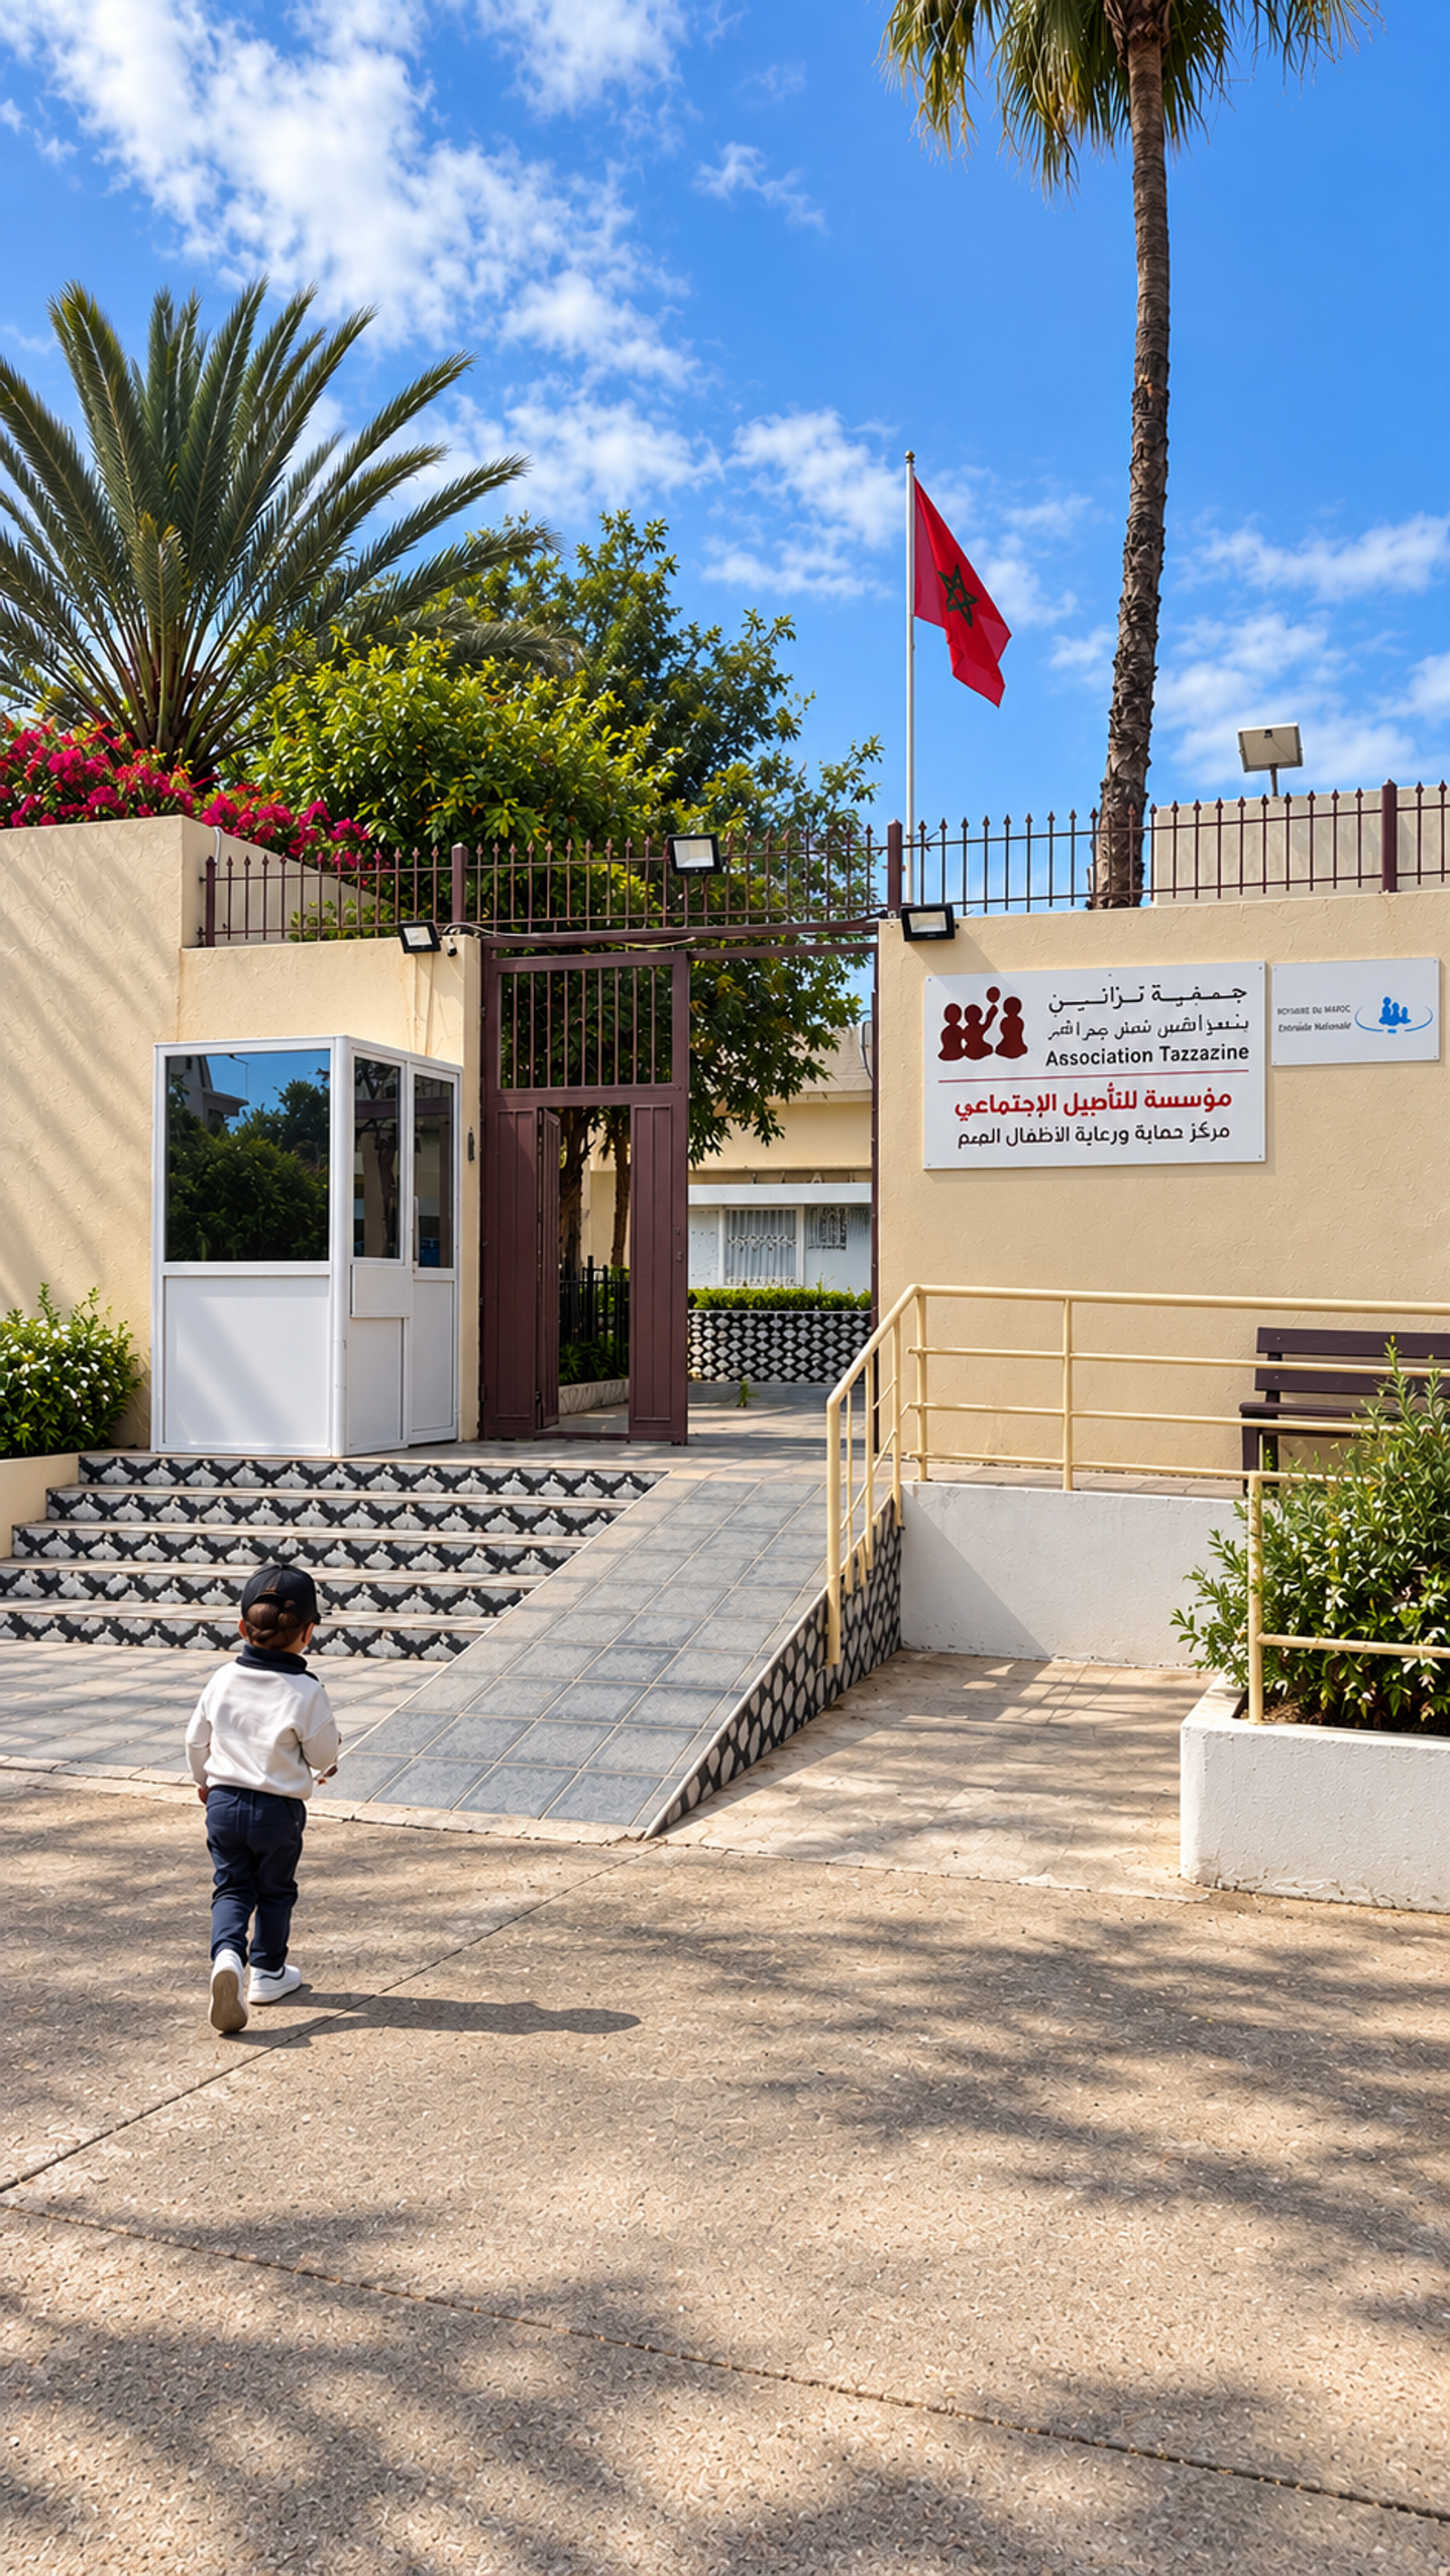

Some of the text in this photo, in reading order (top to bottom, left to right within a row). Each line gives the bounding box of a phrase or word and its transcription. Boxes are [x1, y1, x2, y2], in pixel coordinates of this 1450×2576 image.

[1045, 1043, 1250, 1066] Association Tazzazine
[954, 1093, 1057, 1122] الإجتماعي
[1144, 1087, 1232, 1113] مؤسسة
[1075, 1125, 1129, 1146] ورعاية
[1189, 1122, 1231, 1143] مركز
